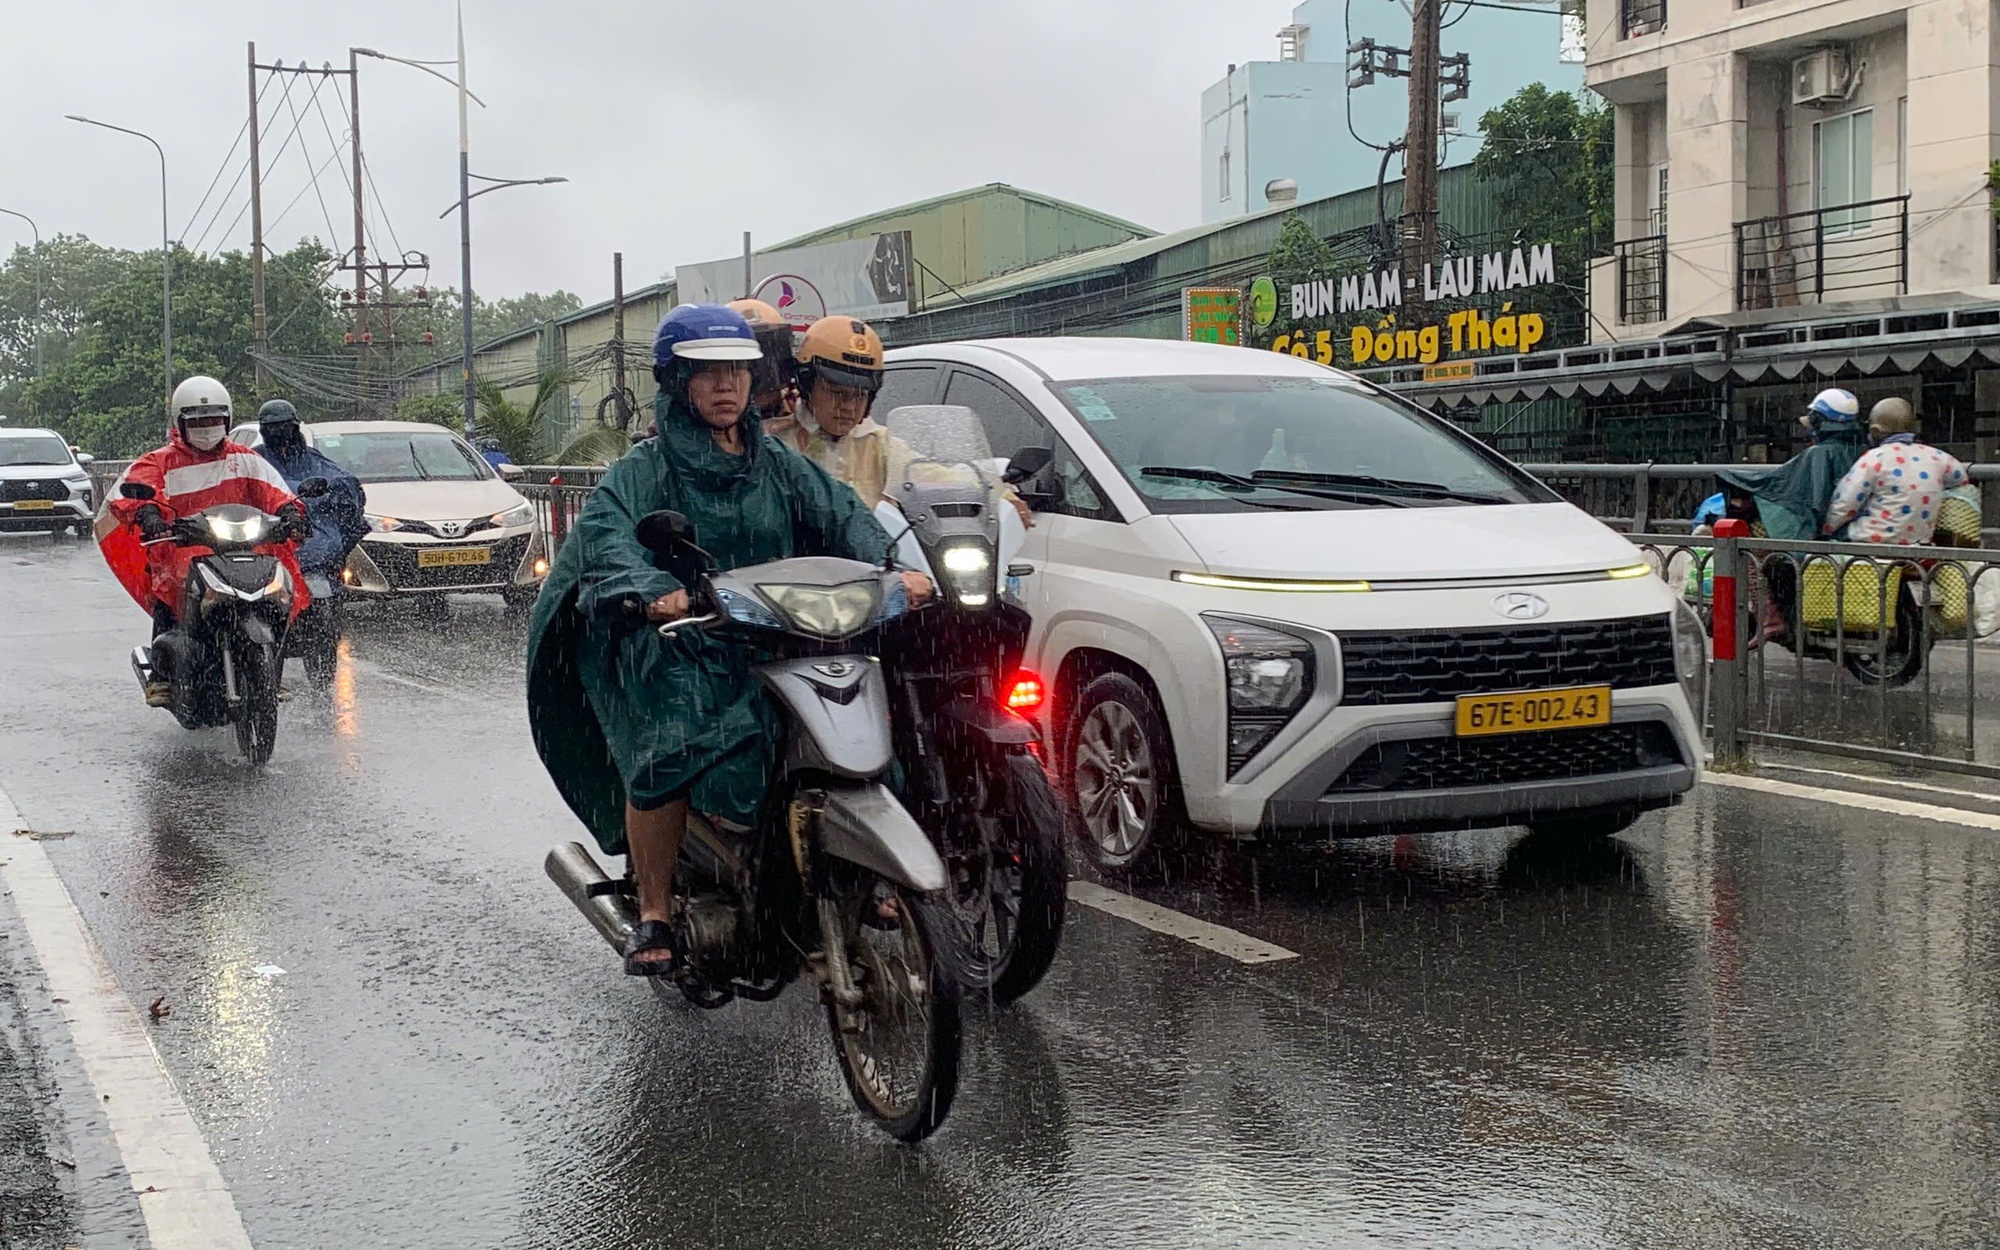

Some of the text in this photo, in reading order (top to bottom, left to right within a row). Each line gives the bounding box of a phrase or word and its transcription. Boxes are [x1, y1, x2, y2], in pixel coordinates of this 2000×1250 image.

[1316, 330, 1333, 366] 5
[1351, 314, 1439, 364] Đồng
[1448, 301, 1544, 353] Tháp
[1471, 694, 1599, 729] 67E-002.43
